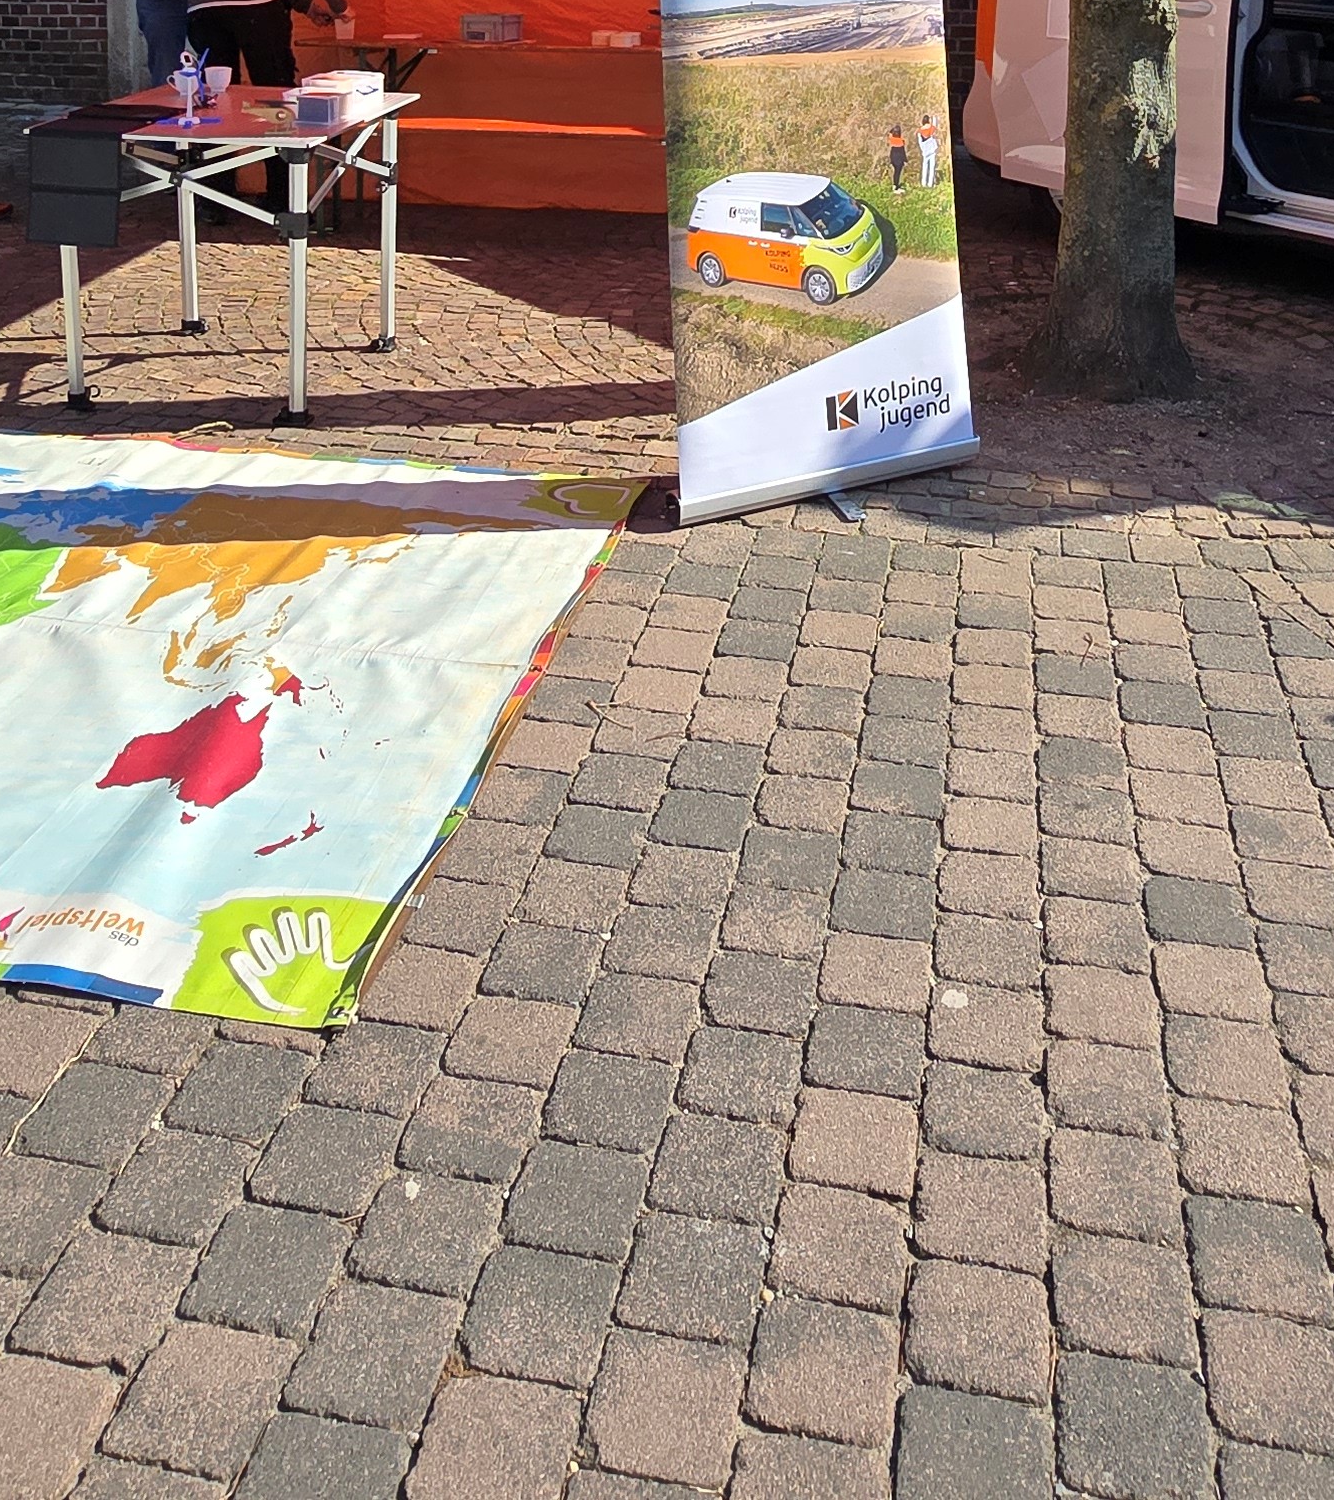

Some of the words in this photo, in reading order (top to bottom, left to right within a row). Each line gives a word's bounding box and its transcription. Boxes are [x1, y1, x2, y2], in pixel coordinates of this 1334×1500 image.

[863, 376, 942, 409] Kolping
[879, 393, 951, 434] jugend
[108, 930, 139, 947] das
